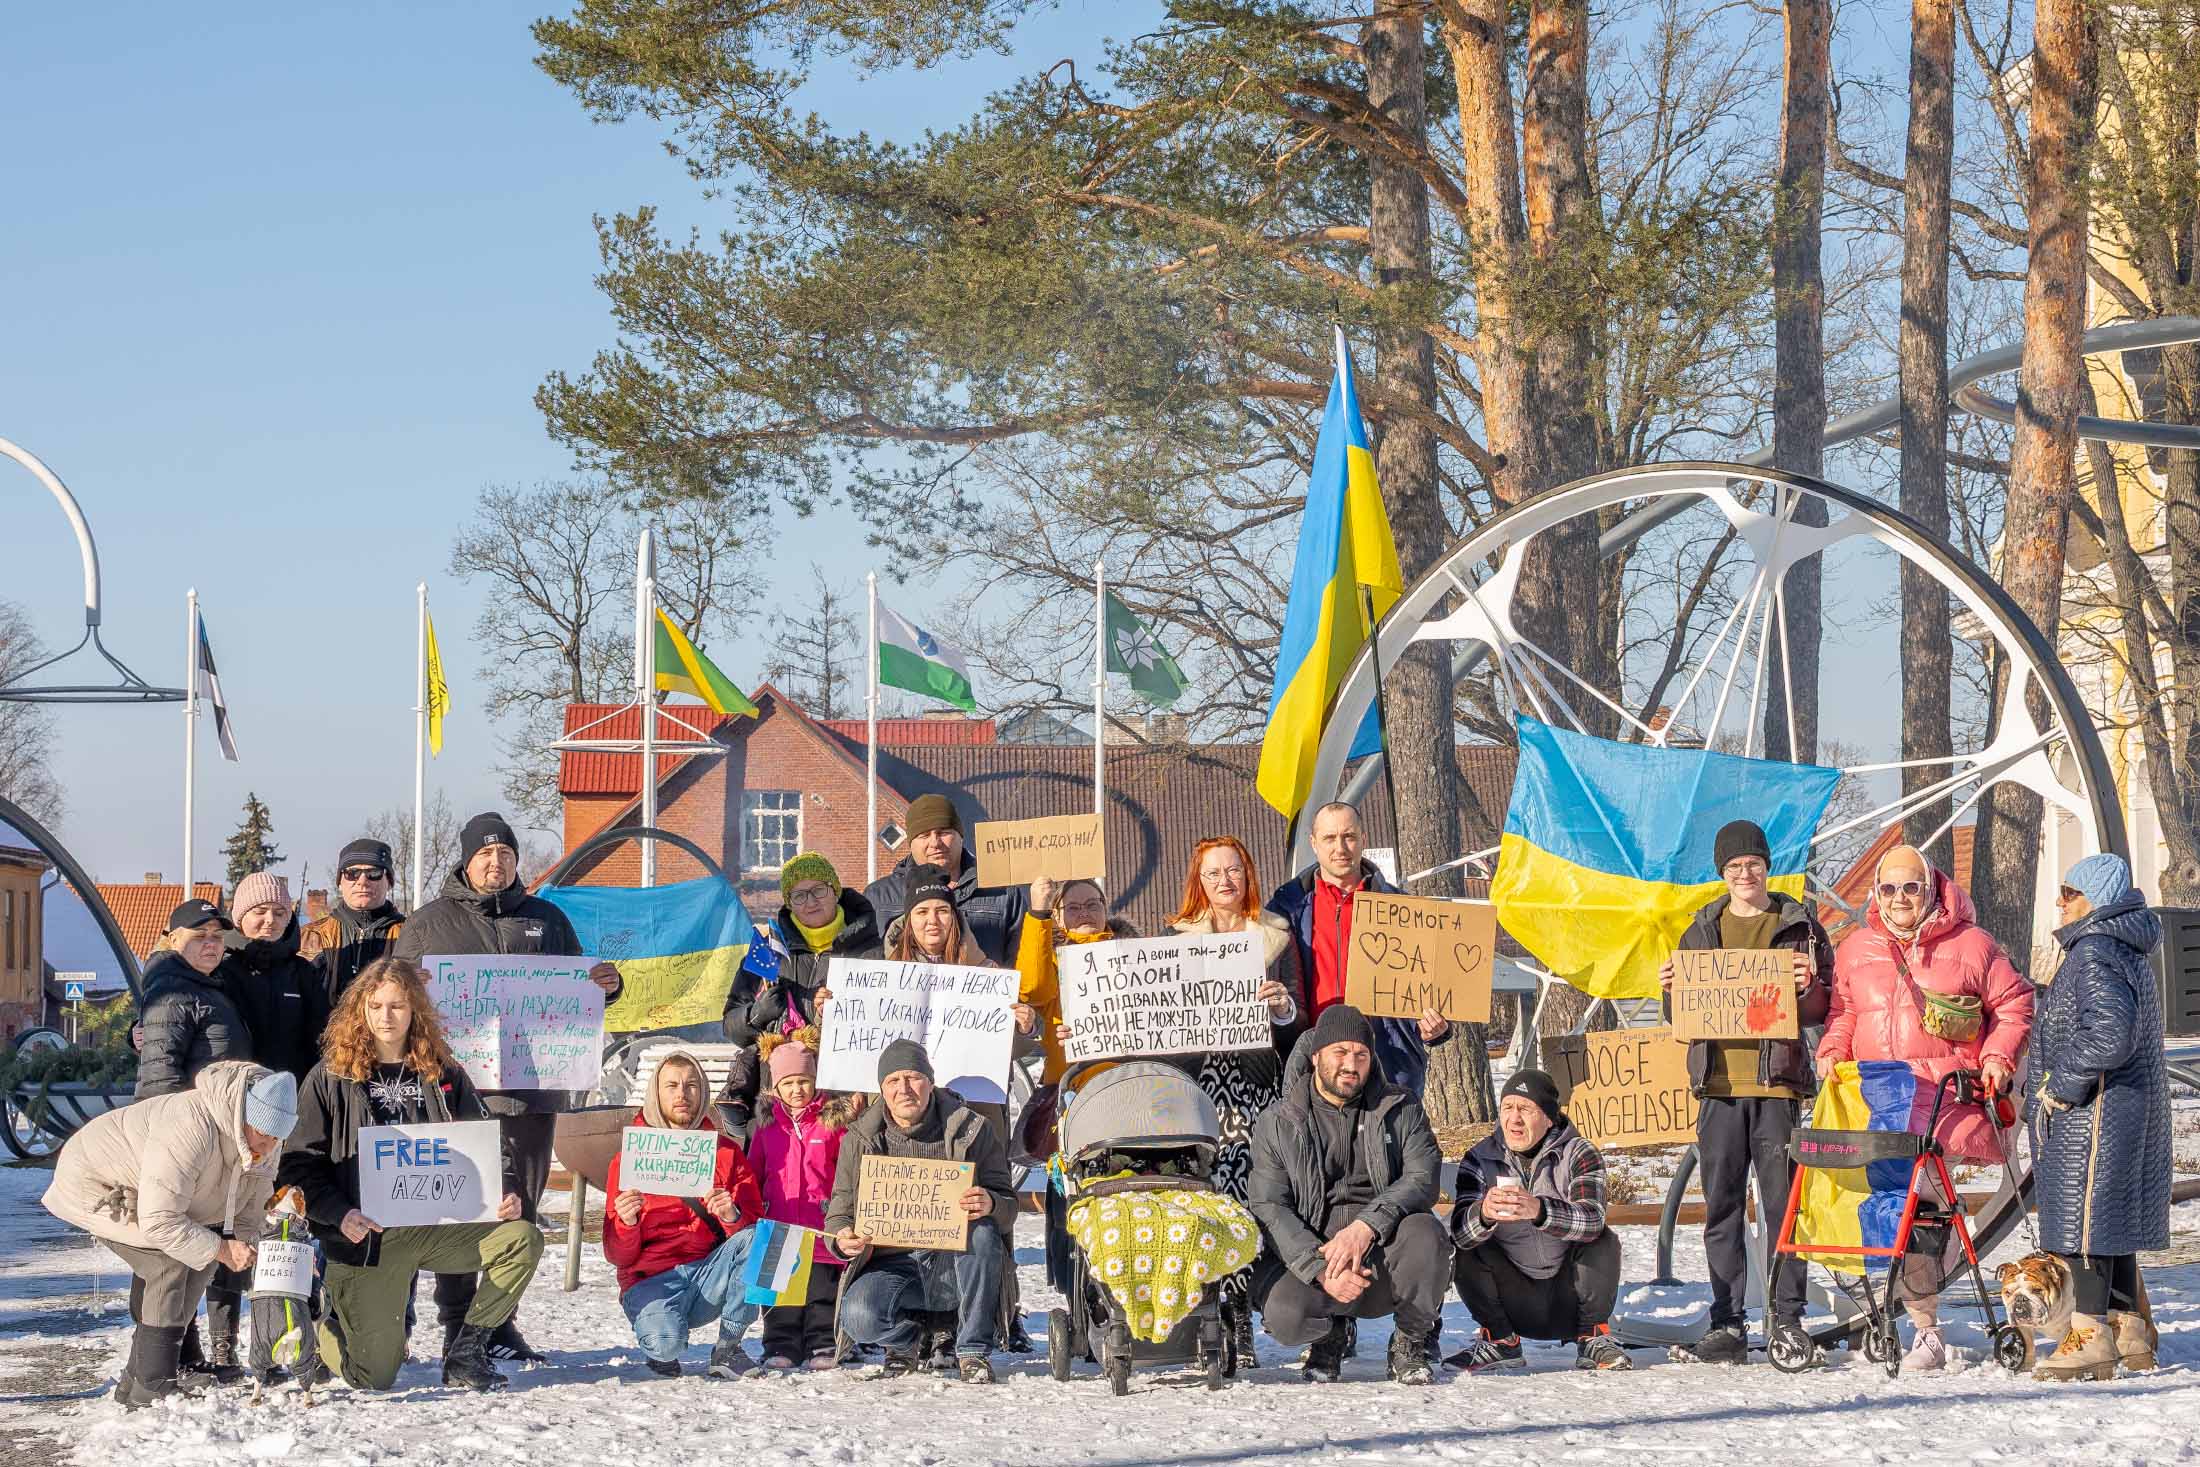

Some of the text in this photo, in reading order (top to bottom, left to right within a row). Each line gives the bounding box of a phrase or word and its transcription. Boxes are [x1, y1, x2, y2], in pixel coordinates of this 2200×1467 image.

[1084, 951, 1098, 975] Я
[845, 971, 889, 989] ANNETA
[1373, 975, 1453, 1015] НАМИ
[1074, 1010, 1120, 1037] ВОНИ
[1125, 1010, 1146, 1032] НЕ
[1147, 1007, 1202, 1032] МОЖУТЬ
[1071, 1038, 1090, 1059] НЕ
[1567, 1087, 1699, 1140] ANGELASED
[375, 1137, 452, 1171] FREE
[932, 1167, 960, 1181] ALSO
[391, 1173, 467, 1203] AZOV
[859, 1201, 890, 1219] HELP
[862, 1219, 901, 1239] STOP
